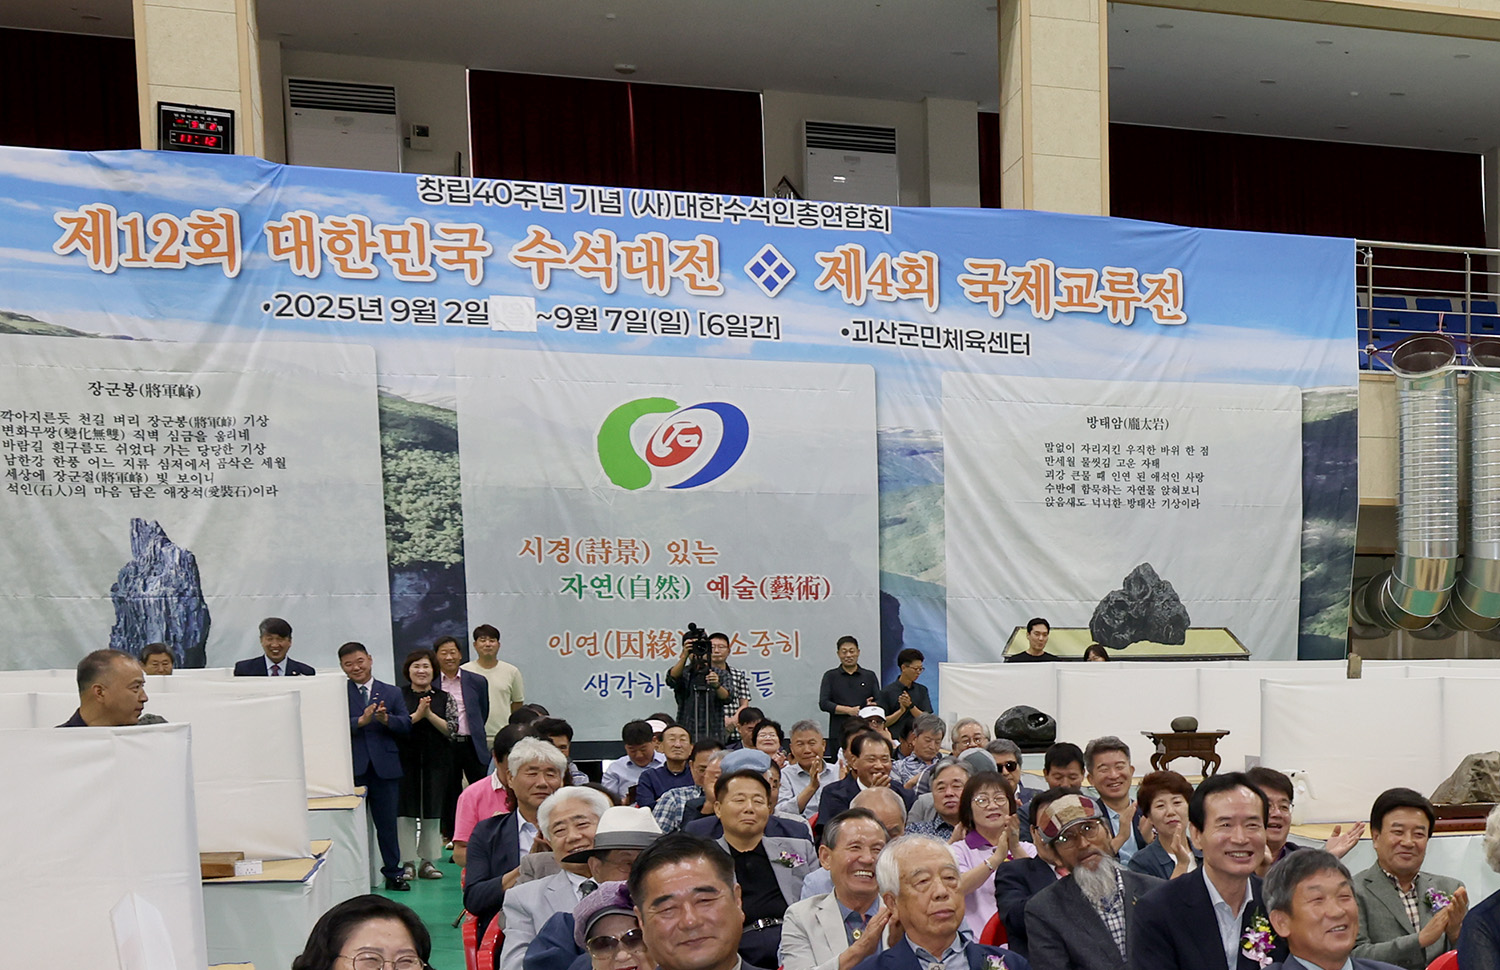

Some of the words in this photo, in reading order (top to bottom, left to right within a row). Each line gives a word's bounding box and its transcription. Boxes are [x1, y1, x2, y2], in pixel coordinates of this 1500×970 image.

[180, 134, 217, 147] 11:12
[418, 177, 564, 210] 창립40주년
[573, 191, 623, 215] 기념
[630, 191, 890, 232] (사)대한수석인총연합회
[57, 205, 237, 273] 제12회
[266, 213, 488, 281] 대한민국
[513, 228, 721, 295] 수석대전
[819, 247, 936, 310] 제4회
[962, 258, 1183, 322] 국제교류전
[274, 294, 383, 324] 2025년
[390, 300, 437, 324] 9월
[445, 303, 489, 326] 2일
[536, 307, 597, 332] ~9월
[604, 310, 690, 337] 7일(일)
[700, 312, 780, 339] [6일간]
[852, 320, 1031, 356] 괴산군민체육센터
[78, 413, 105, 426] 천길
[113, 414, 139, 427] 벼리
[244, 415, 269, 427] 기상
[133, 429, 158, 442] 직벽
[167, 430, 208, 443] 심금을
[2, 439, 43, 453] 바람길
[52, 440, 109, 454] 흰구름도
[115, 441, 157, 456] 쉬었다
[163, 444, 190, 456] 가는
[197, 442, 234, 456] 당당한
[241, 443, 267, 455] 기상
[1045, 442, 1074, 453] 말없이
[1081, 443, 1120, 455] 자리지킨
[1126, 444, 1156, 455] 우직한
[1161, 445, 1179, 456] 바위
[1185, 445, 1195, 456] 한
[1200, 446, 1208, 456] 점
[4, 454, 45, 467] 남한강
[88, 456, 115, 469] 어느
[123, 457, 150, 470] 지류
[157, 458, 210, 471] 심저에서
[261, 457, 286, 469] 세월
[1045, 455, 1075, 467] 만세월
[1116, 458, 1136, 469] 고운
[1141, 458, 1160, 469] 자태
[5, 468, 45, 482] 세상에
[156, 472, 168, 484] 빛
[176, 472, 214, 484] 보이니
[1045, 469, 1066, 480] 괴강
[1112, 471, 1130, 482] 인연
[1151, 472, 1180, 482] 애석인
[1186, 472, 1205, 483] 사랑
[7, 483, 86, 497] 석인(石人)의
[94, 486, 122, 498] 마음
[128, 485, 158, 498] 담은
[1045, 483, 1075, 494] 수반에
[1127, 485, 1156, 495] 자연물
[1127, 498, 1156, 509] 방태산
[1162, 498, 1200, 509] 기상이라
[519, 536, 651, 566] 시경(詩景)
[666, 538, 719, 566] 있는
[561, 573, 691, 601] 자연(自然)
[706, 575, 831, 601] 예술(藝術)
[729, 630, 800, 657] 소중히
